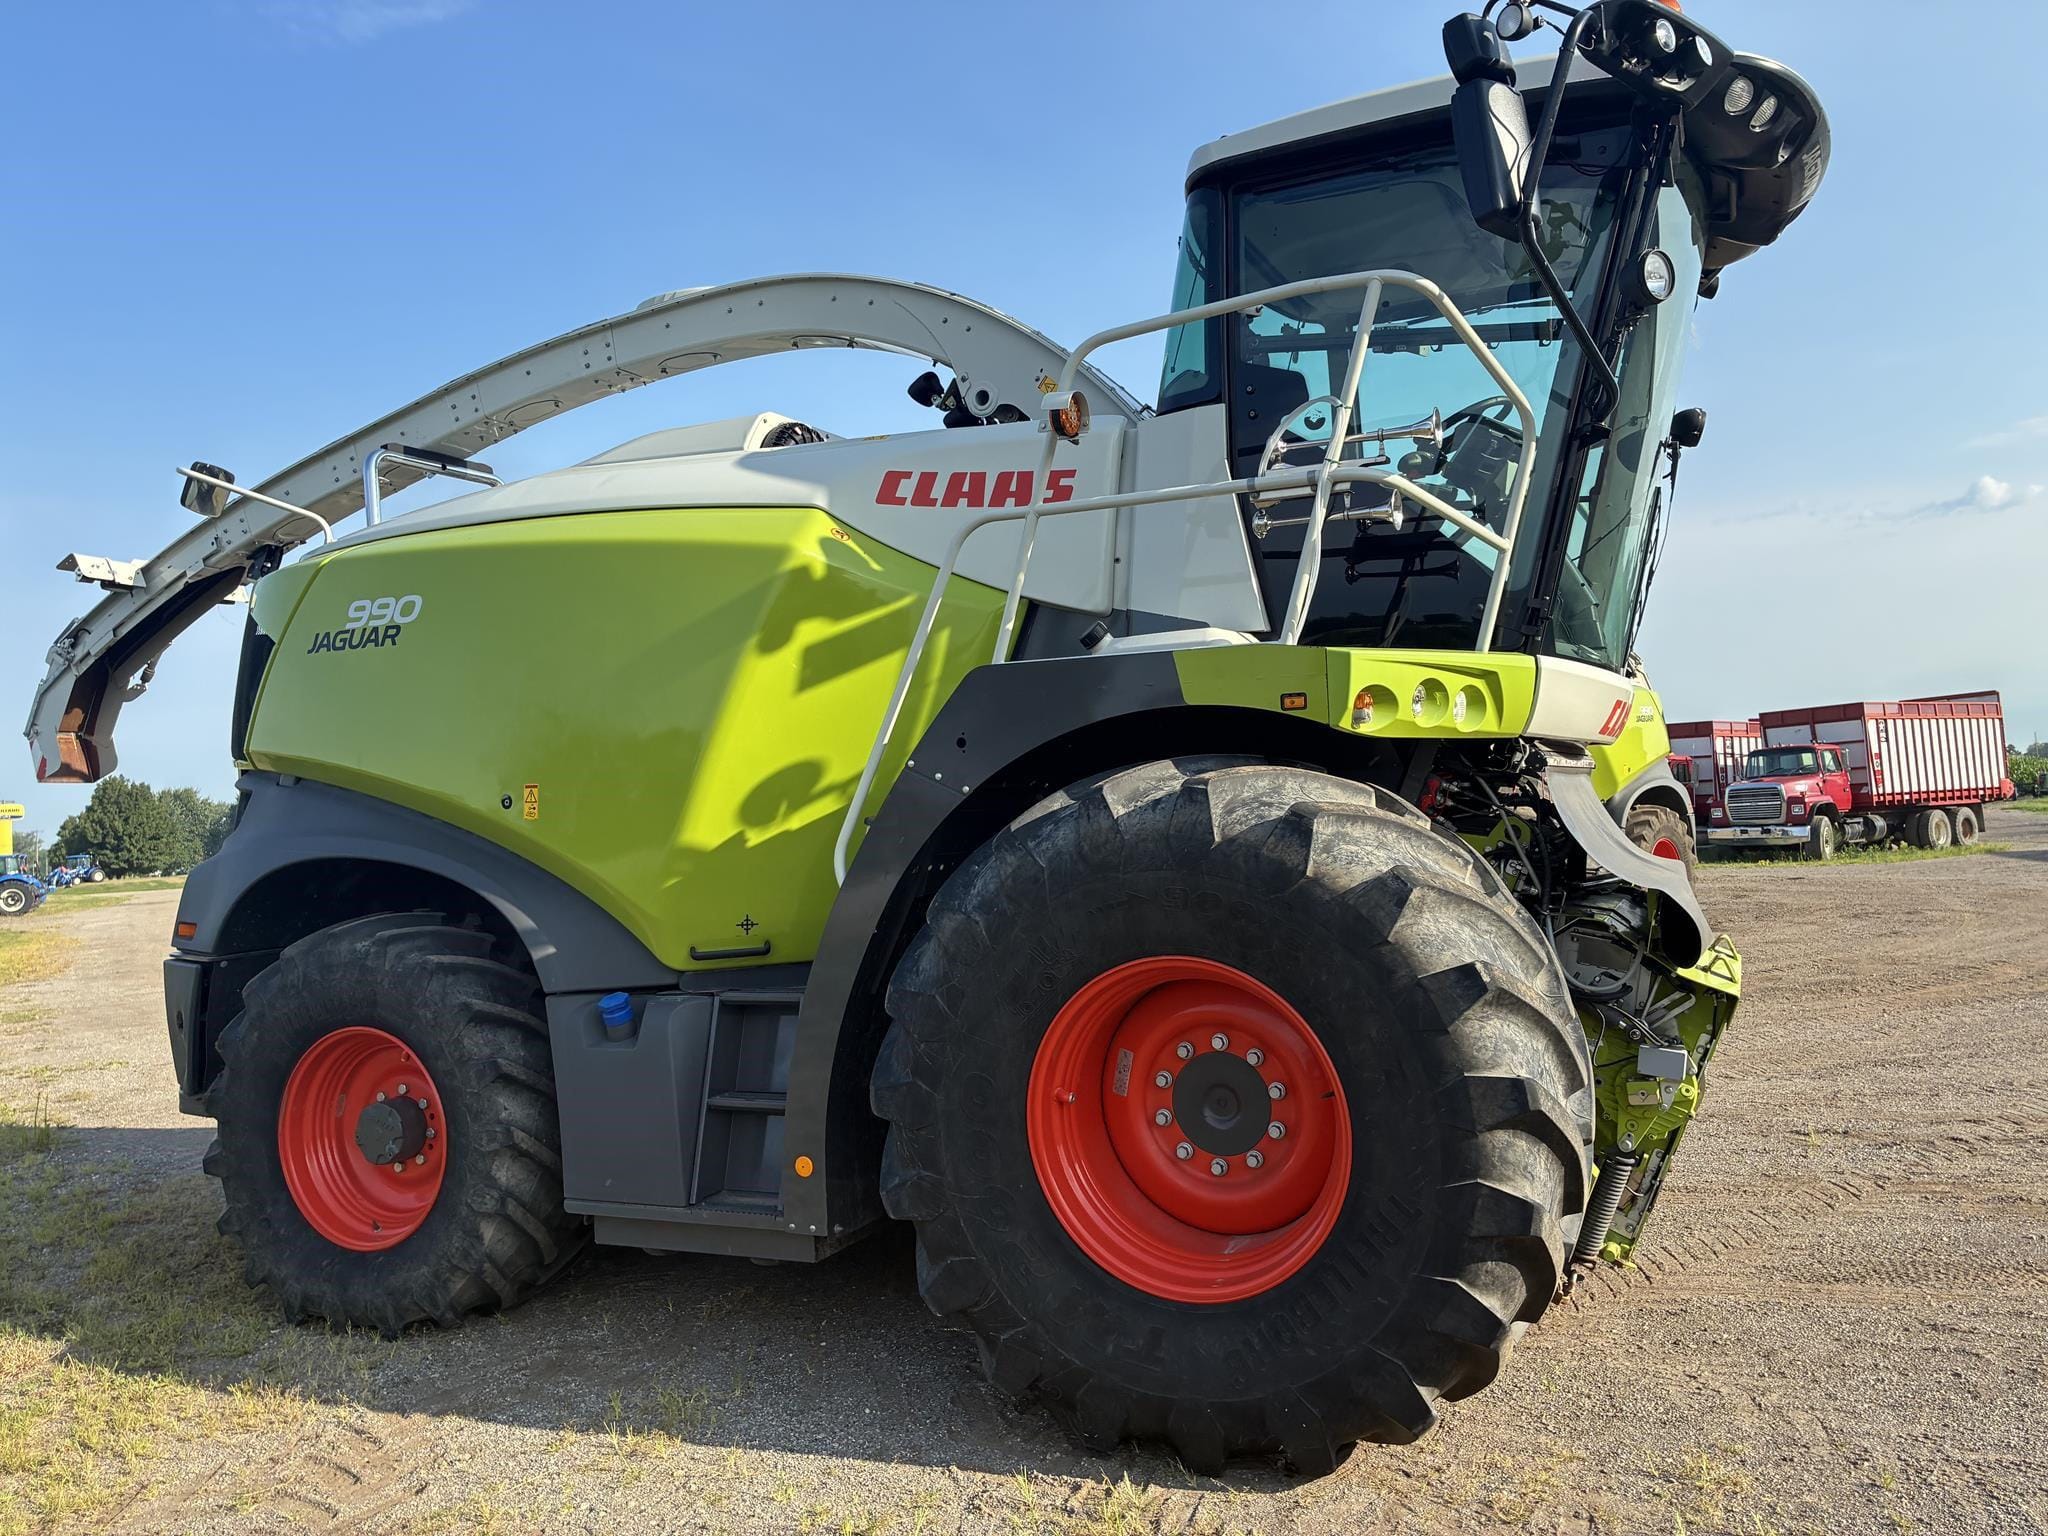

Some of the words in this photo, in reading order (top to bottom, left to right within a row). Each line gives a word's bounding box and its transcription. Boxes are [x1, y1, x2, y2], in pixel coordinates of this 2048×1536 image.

[875, 469, 1077, 507] CLAAS
[346, 594, 423, 629] 990
[307, 624, 402, 655] JAGUAR
[1635, 714, 1655, 723] JAGUAR
